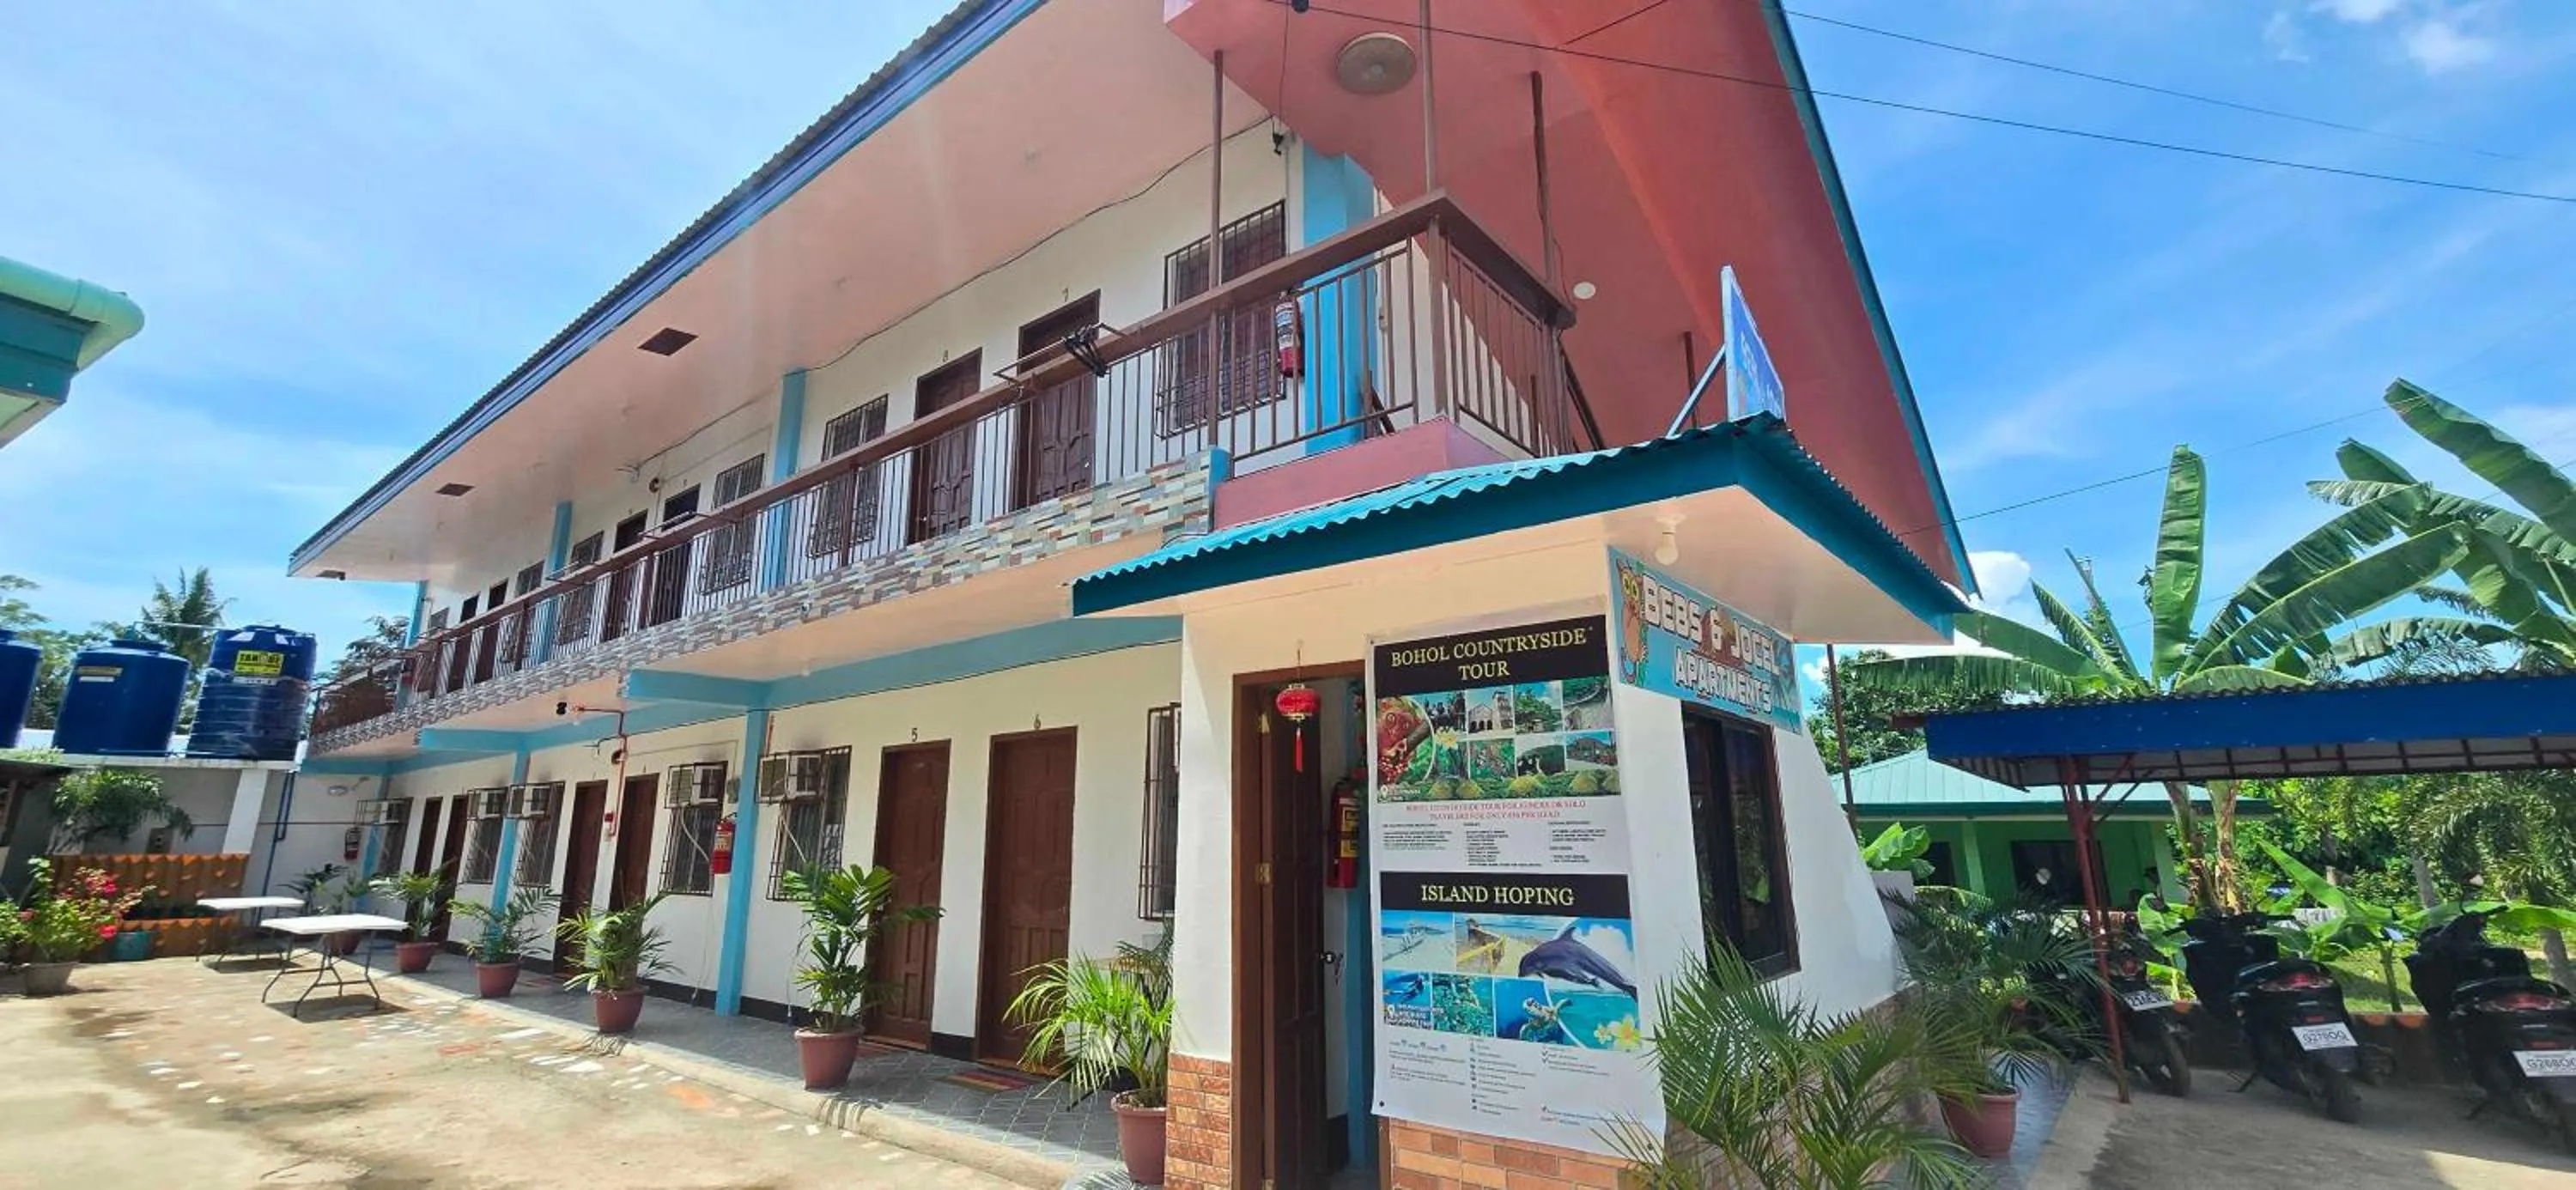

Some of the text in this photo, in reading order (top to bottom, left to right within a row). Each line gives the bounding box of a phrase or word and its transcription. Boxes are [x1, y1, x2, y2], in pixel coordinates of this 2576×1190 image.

[1641, 574, 1703, 643] BEBS
[1391, 628, 1587, 667] BOHOL COUNTRYSIDE
[1459, 660, 1510, 680] TOUR
[1675, 647, 1772, 714] APARTMENTS
[1034, 713, 1042, 729] 6
[910, 727, 918, 742] 5
[1421, 884, 1575, 906] ISLAND HOPING
